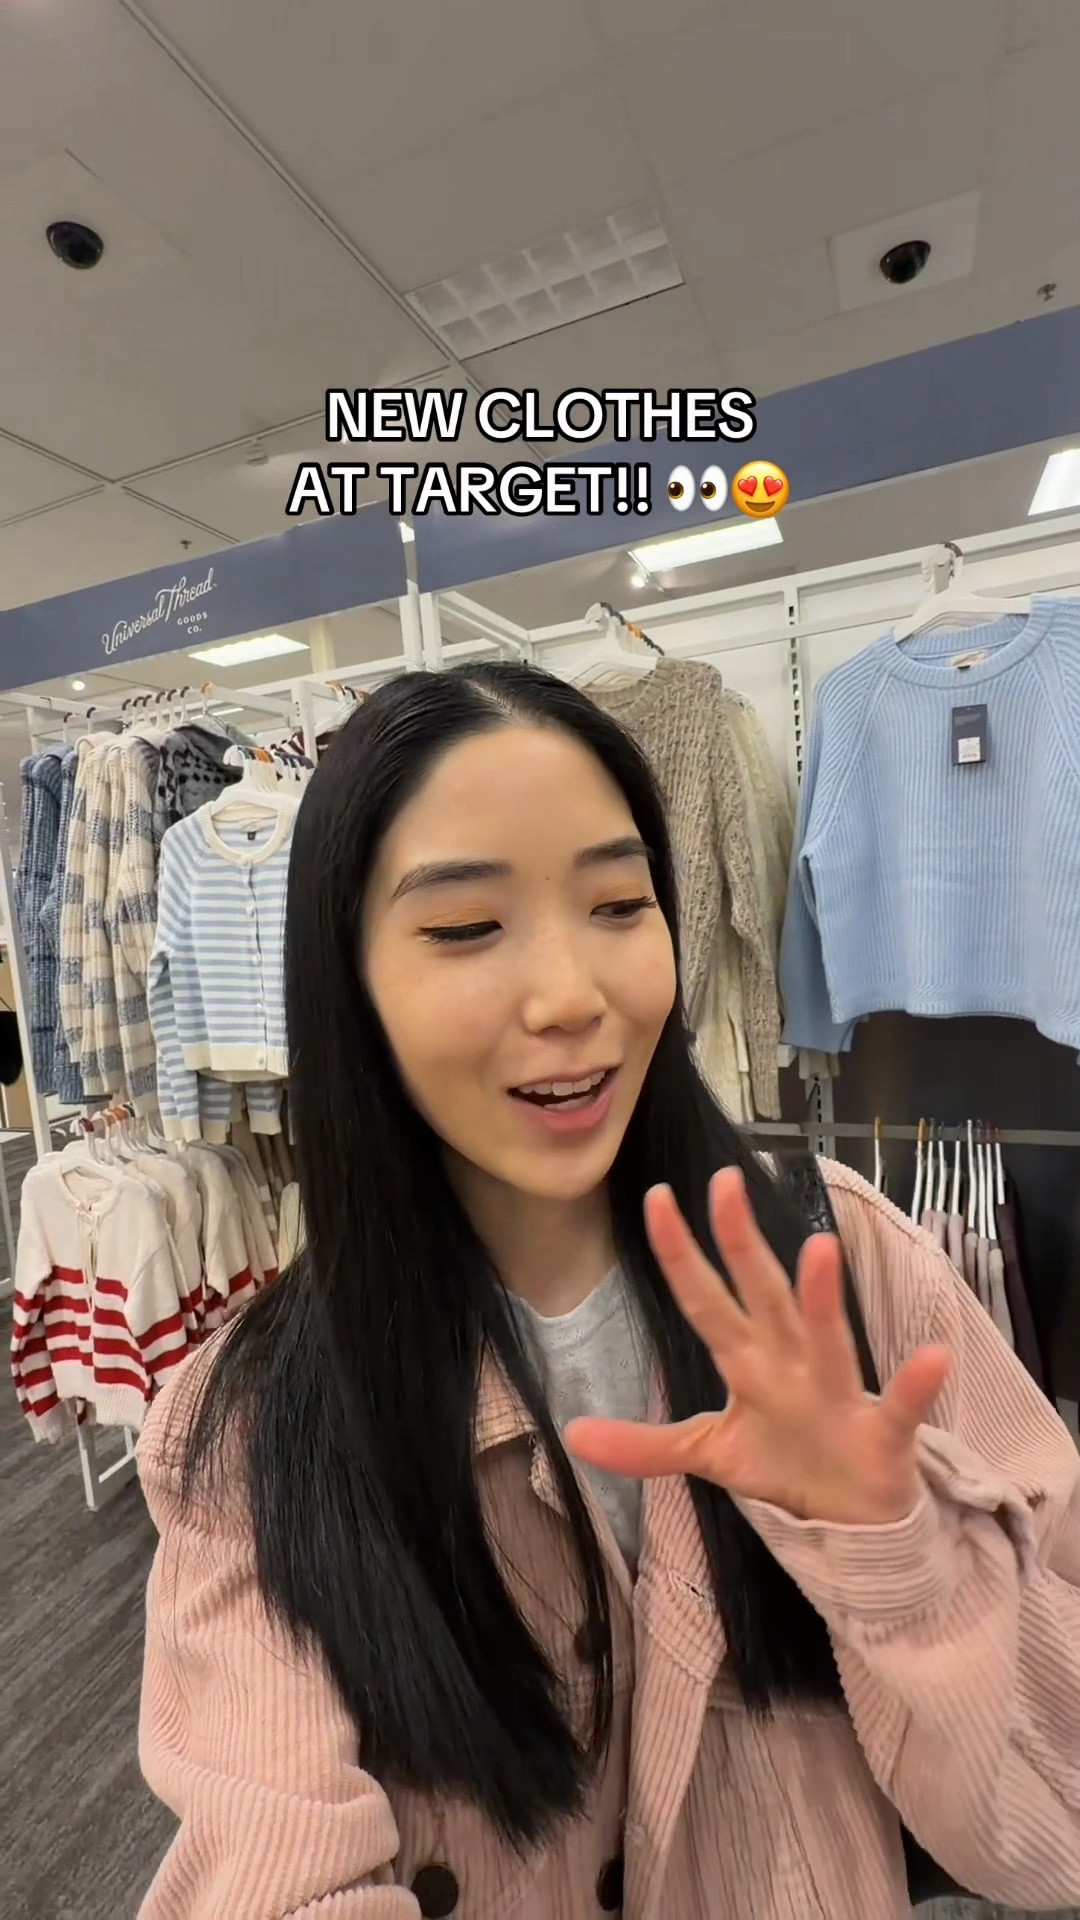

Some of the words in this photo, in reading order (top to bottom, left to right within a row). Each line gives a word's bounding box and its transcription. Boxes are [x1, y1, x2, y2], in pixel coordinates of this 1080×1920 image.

[101, 594, 166, 655] Universal
[155, 567, 214, 622] Thread
[177, 611, 208, 626] GOODS
[187, 625, 202, 635] CO.
